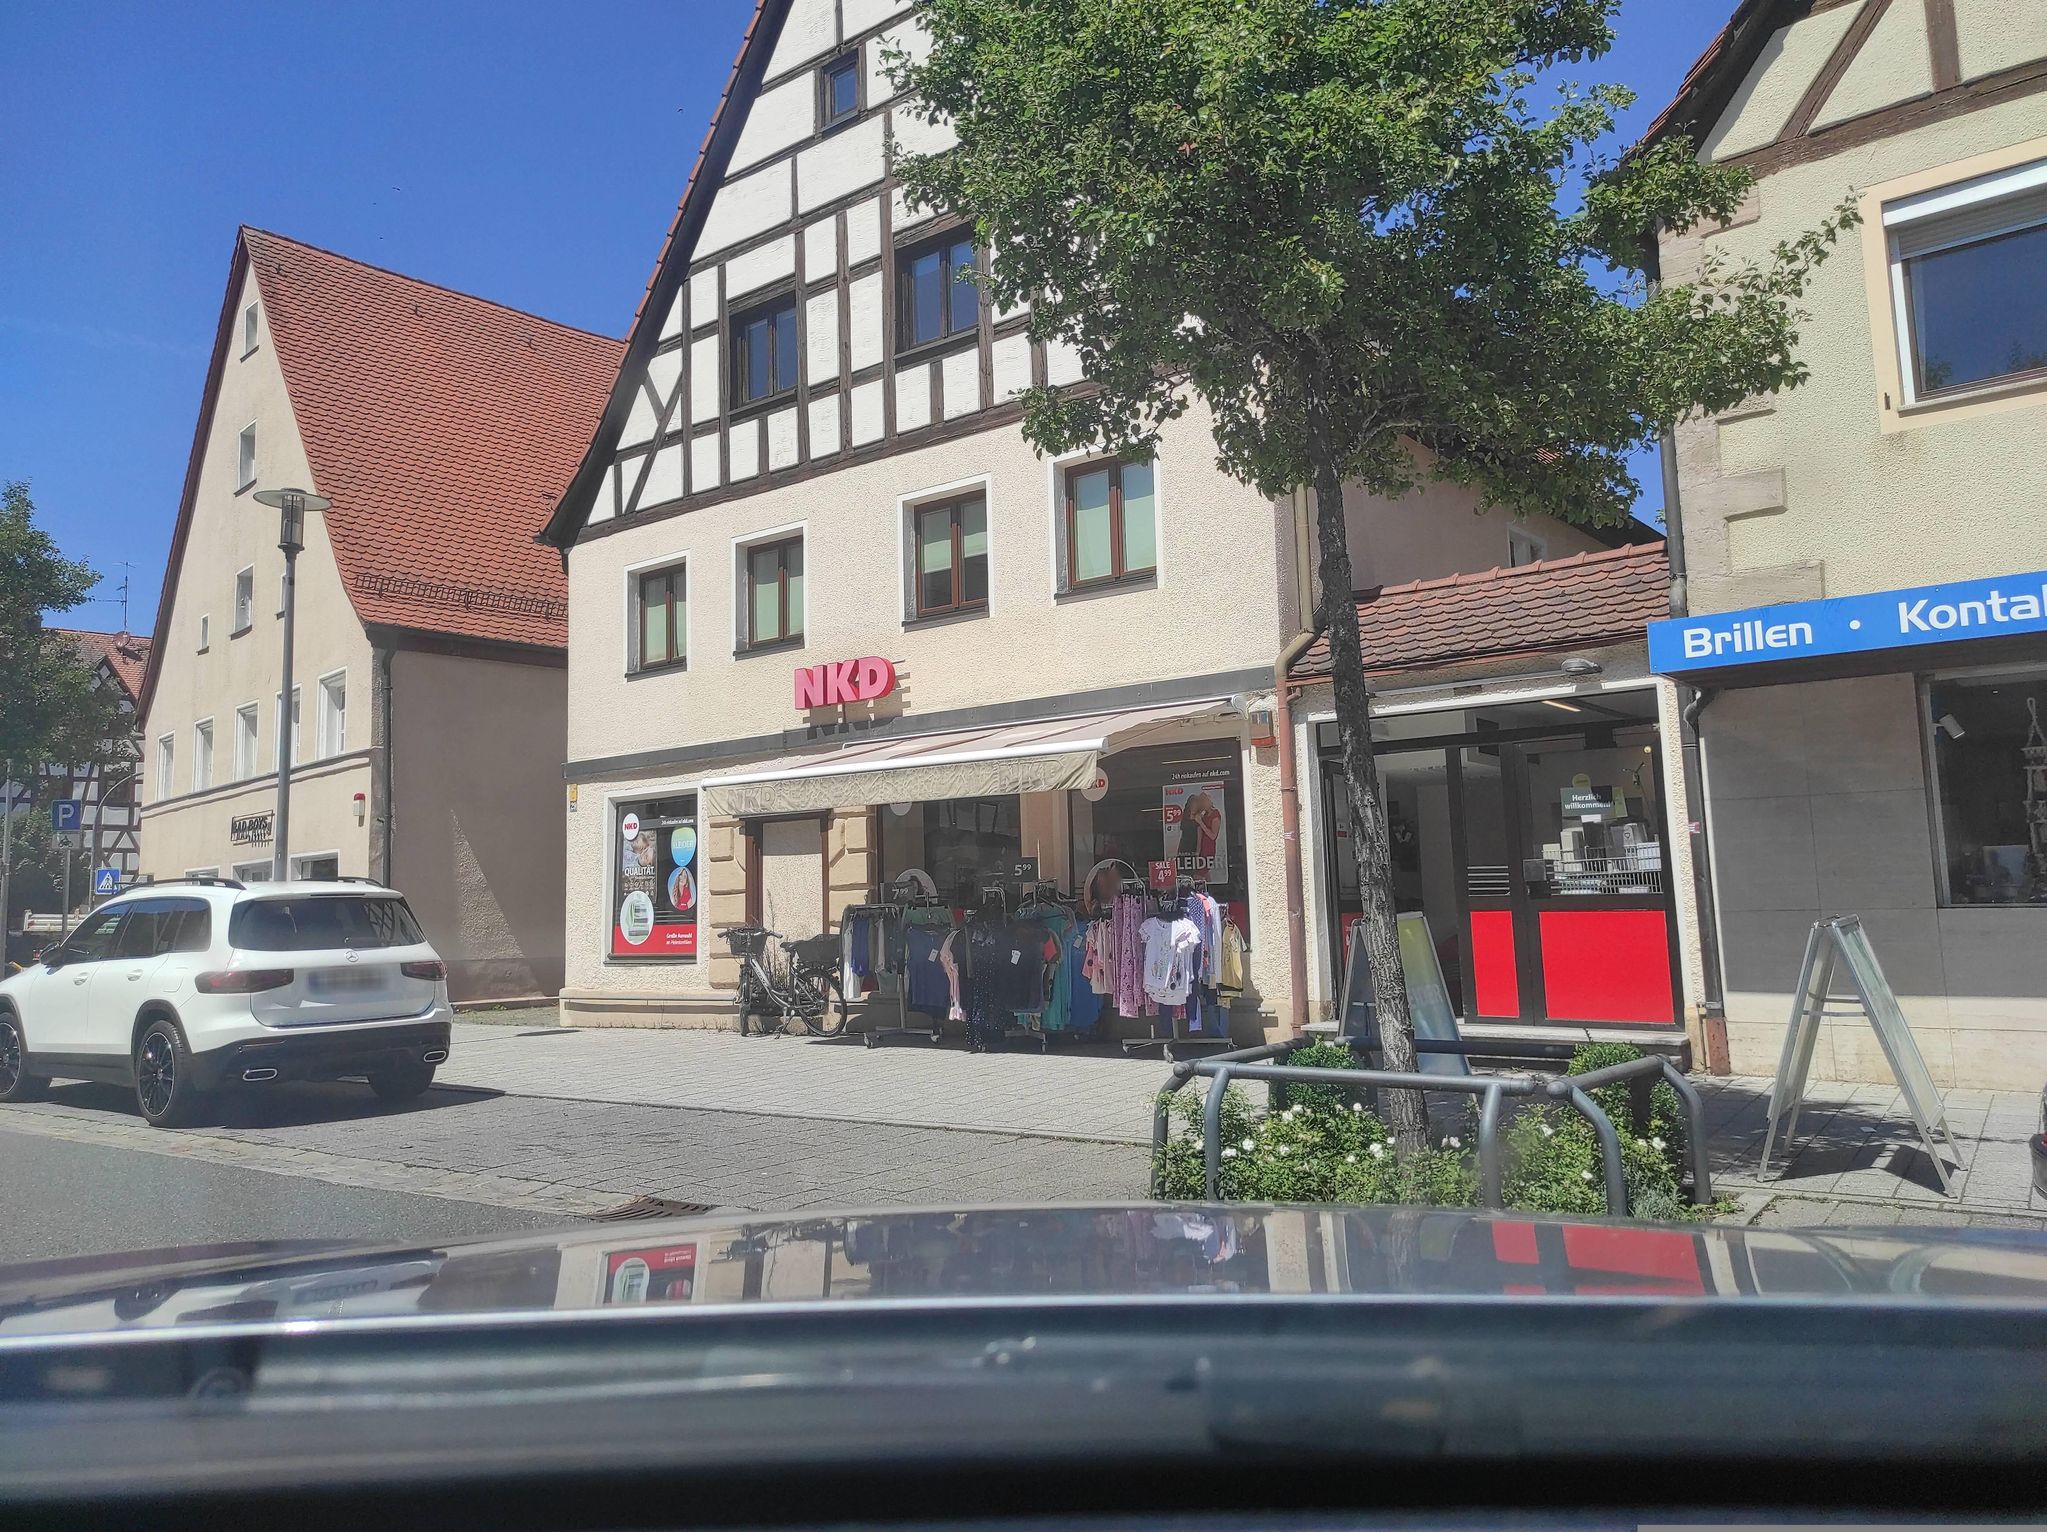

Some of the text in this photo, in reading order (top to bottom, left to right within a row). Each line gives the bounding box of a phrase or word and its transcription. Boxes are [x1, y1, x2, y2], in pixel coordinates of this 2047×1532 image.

[1683, 620, 1813, 659] Brillen
[795, 656, 896, 710] NKD
[1209, 769, 1230, 777] nkd.com
[58, 804, 75, 827] P
[248, 816, 268, 831] BOYS
[624, 822, 638, 830] NKD
[1168, 855, 1224, 870] LEIDER
[624, 865, 655, 876] QUALITÄT
